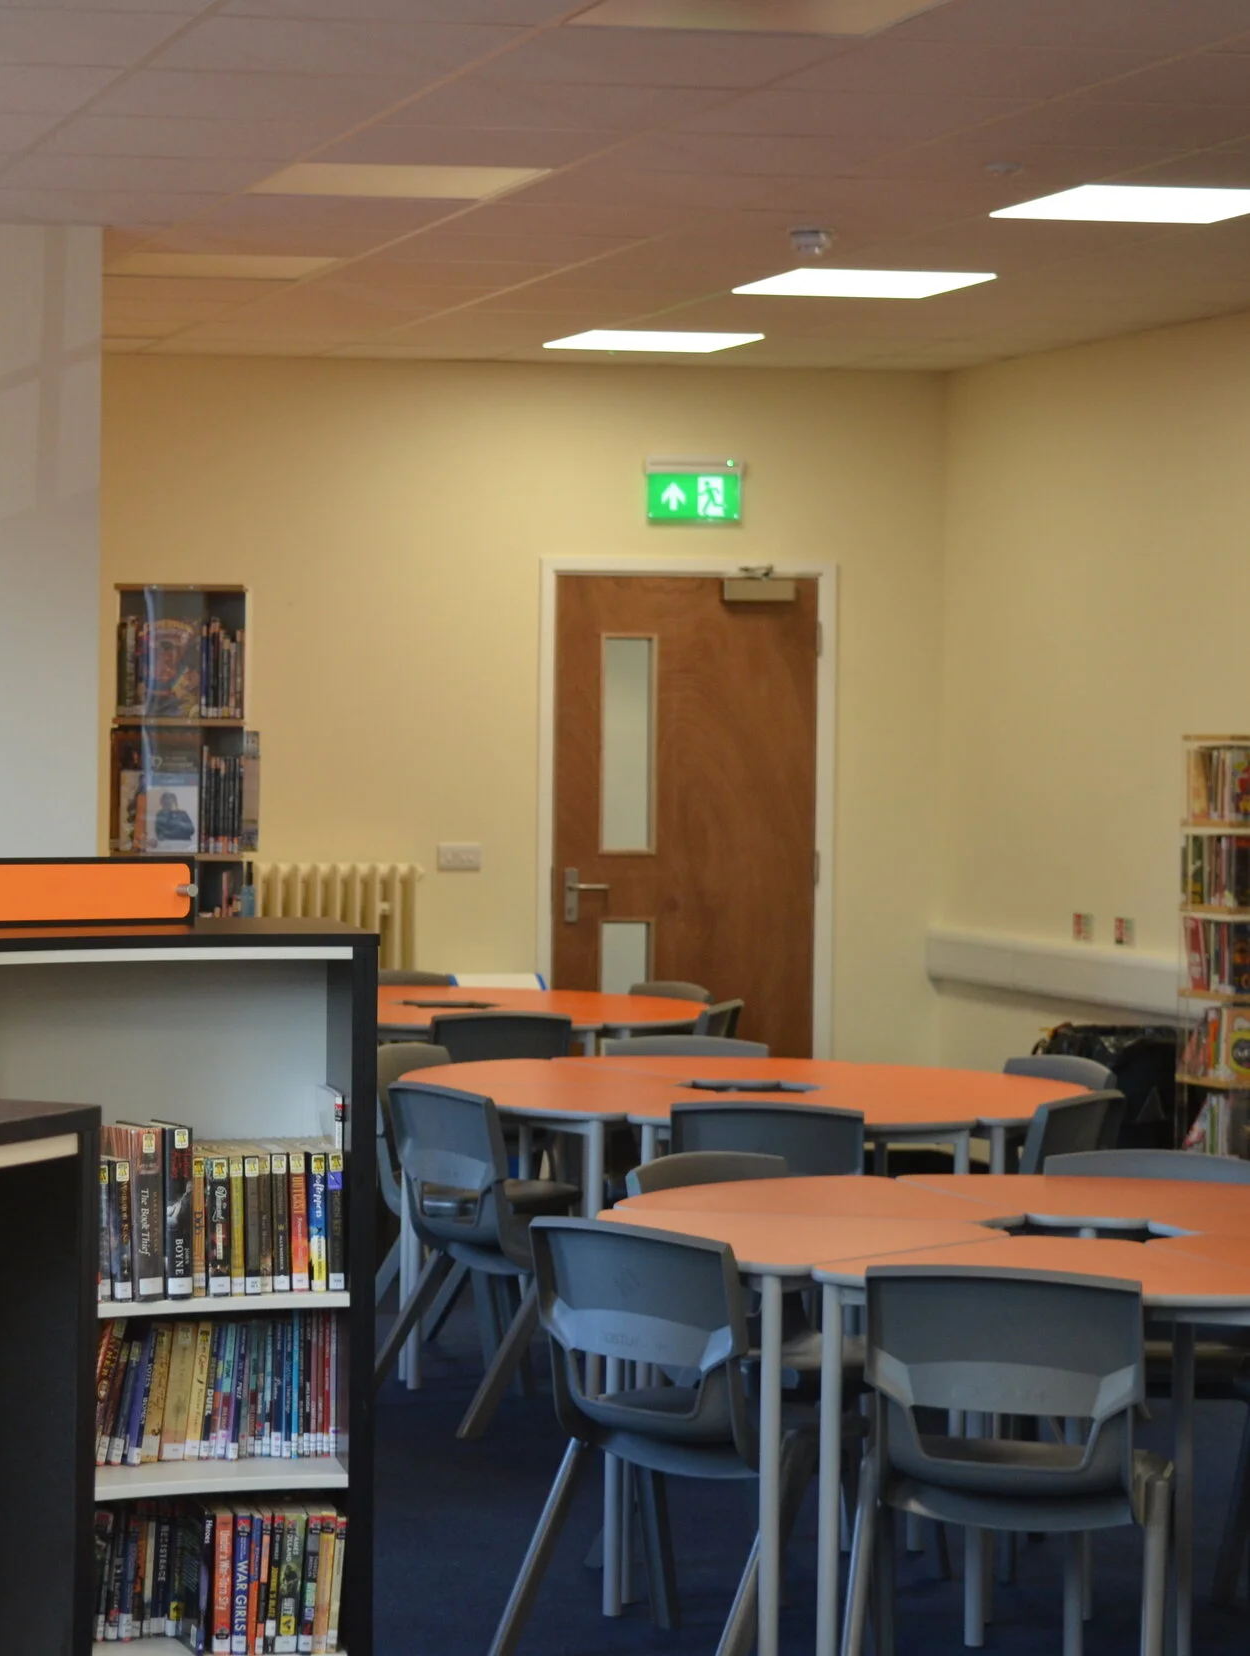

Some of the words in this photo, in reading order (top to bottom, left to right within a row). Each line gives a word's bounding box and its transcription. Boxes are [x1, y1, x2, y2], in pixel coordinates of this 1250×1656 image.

[140, 1188, 150, 1205] The
[292, 1176, 305, 1215] OUTCAST
[140, 1208, 151, 1229] Book
[139, 1232, 151, 1257] Thief
[174, 1238, 185, 1276] BOYNE
[205, 1388, 215, 1416] DUEL
[204, 1519, 213, 1544] Heroes
[219, 1529, 231, 1553] Under
[285, 1534, 295, 1562] OLLAND
[235, 1560, 248, 1592] WAR
[234, 1594, 248, 1632] GIRLS
